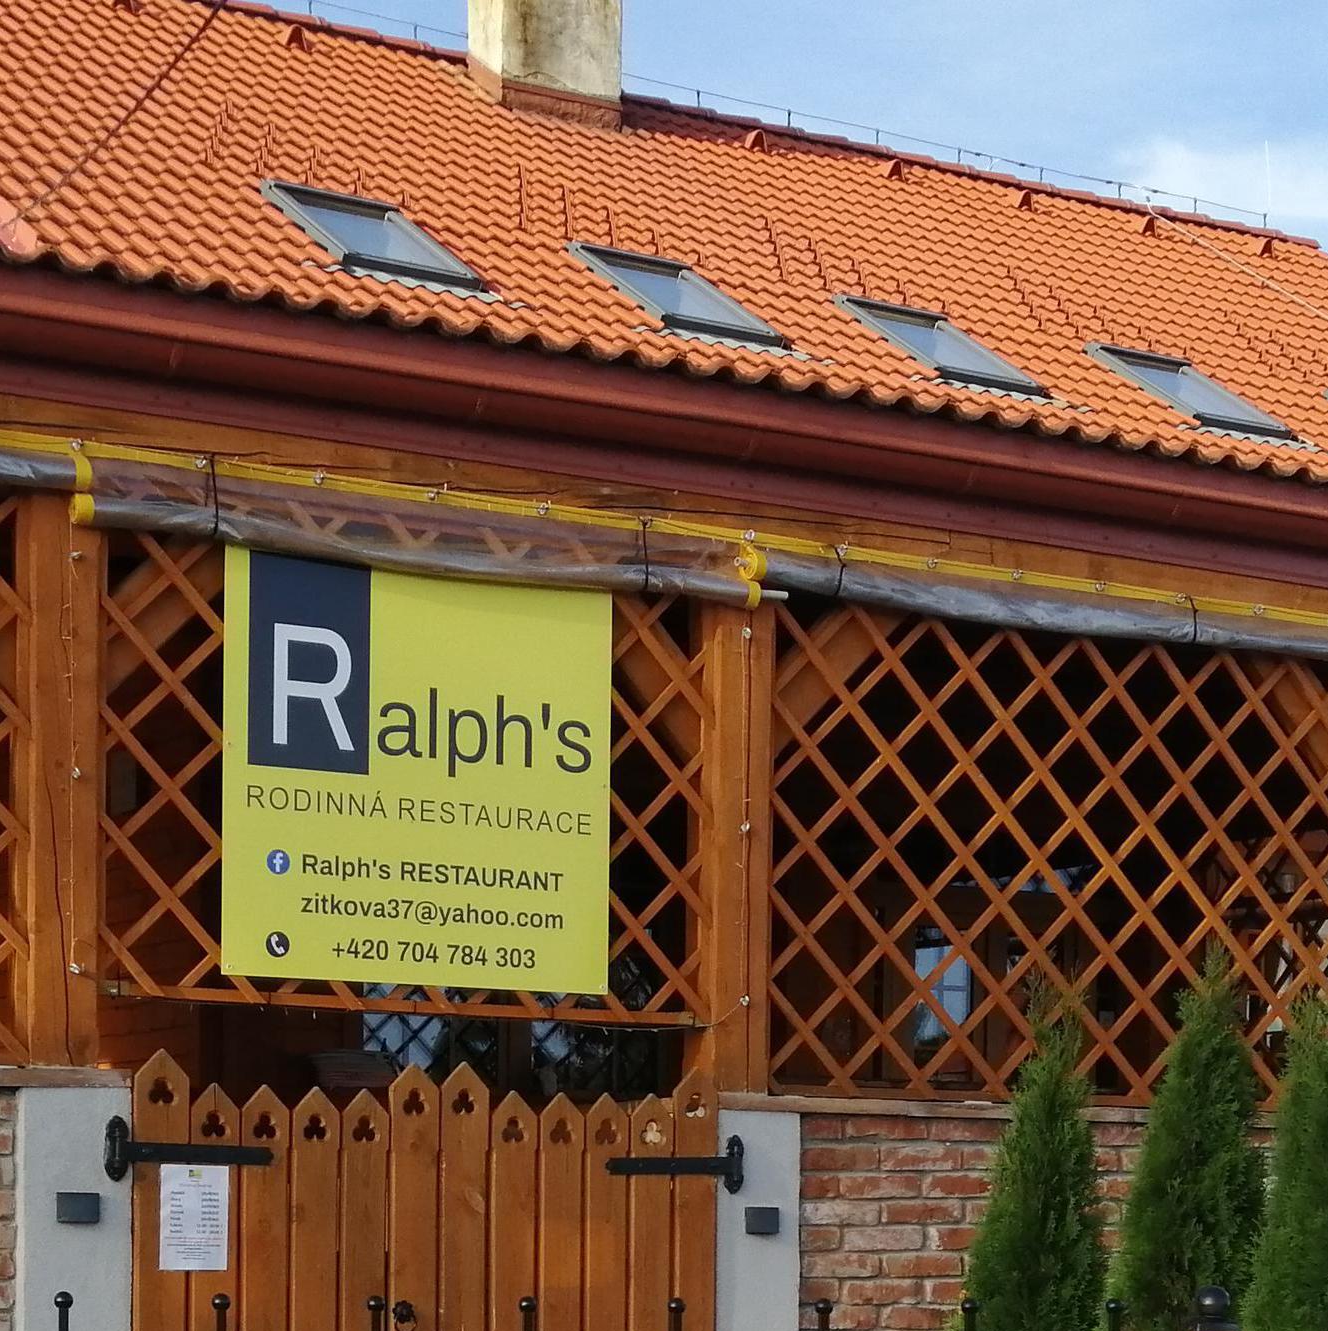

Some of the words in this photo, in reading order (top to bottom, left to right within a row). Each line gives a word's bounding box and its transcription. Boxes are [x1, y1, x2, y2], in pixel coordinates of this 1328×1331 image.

[272, 622, 593, 778] Ralph's
[246, 783, 388, 819] RODINNÁ
[398, 797, 593, 836] RESTAURACE
[301, 852, 392, 881] Ralph's
[399, 861, 564, 892] RESTAURANT
[300, 893, 565, 930] zitkova37@yahoo.com
[331, 938, 390, 961] +420
[397, 940, 441, 964] 704
[446, 943, 489, 967] 784
[495, 946, 537, 970] 303
